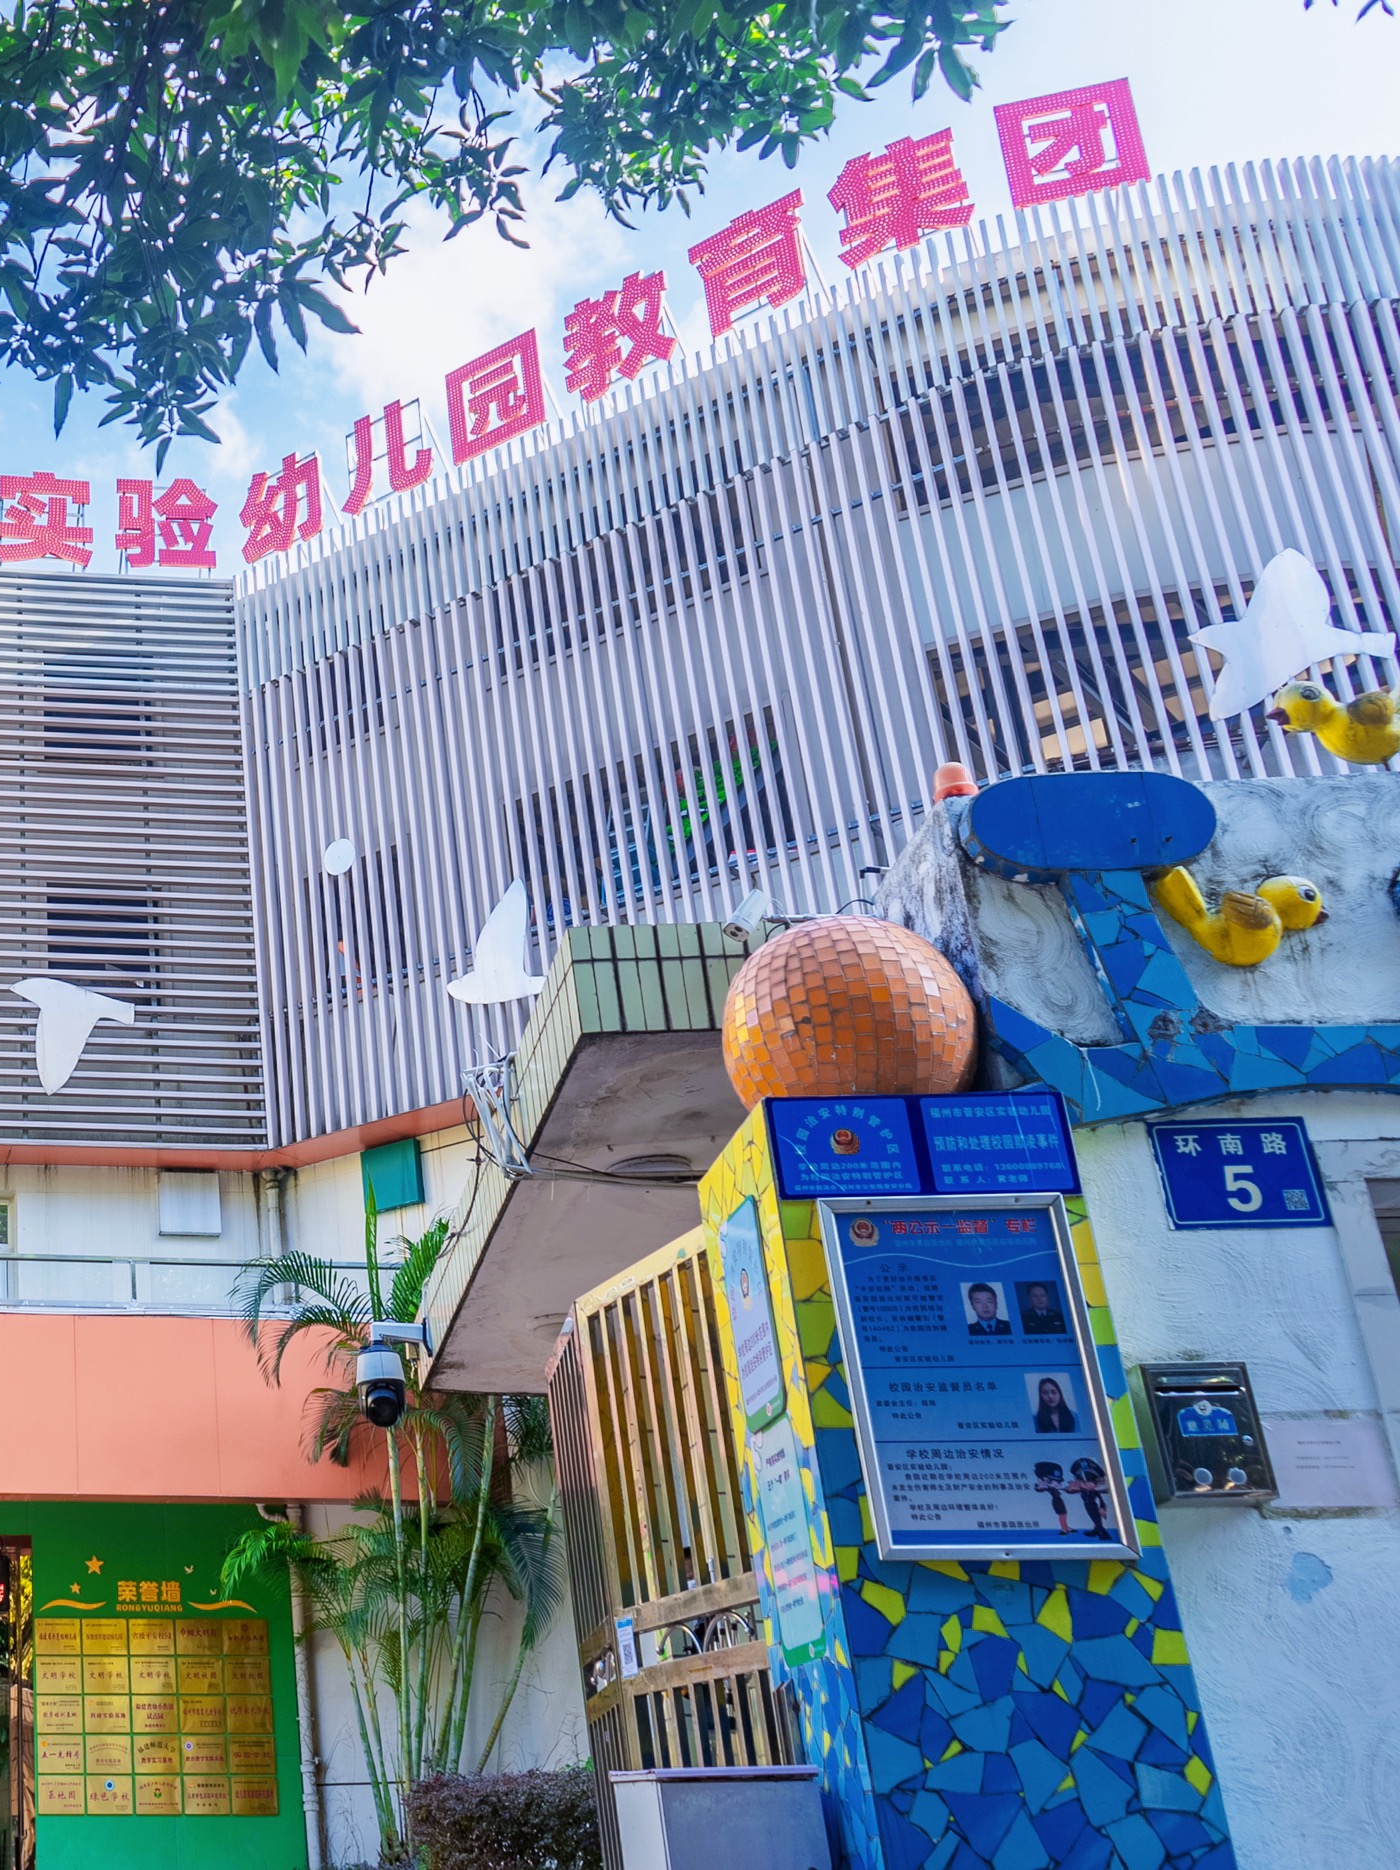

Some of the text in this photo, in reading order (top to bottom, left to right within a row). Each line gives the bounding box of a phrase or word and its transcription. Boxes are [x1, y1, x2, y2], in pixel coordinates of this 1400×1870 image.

[930, 1105, 1051, 1118] 福州市晋安区实验幼儿园
[795, 1104, 899, 1155] 校园治安特别管护区
[933, 1133, 1059, 1151] 预防和处理校园欺凌事件
[1173, 1132, 1287, 1157] 环南路
[798, 1161, 902, 1170] 学校周边200米范围内
[801, 1171, 902, 1181] 为校园治安特别管护区
[1223, 1165, 1263, 1212] 5
[1006, 1218, 1037, 1233] 专栏
[889, 1381, 998, 1393] 校园治安监督员名单
[892, 1412, 922, 1420] 特此公告
[957, 1421, 1019, 1429] 晋安区实验幼儿园
[906, 1448, 1004, 1460] 学校周边治安情况
[911, 1513, 942, 1521] 特此公告
[117, 1580, 181, 1602] 荣誉墙
[116, 1604, 183, 1612] RONGYUQIANG
[42, 1671, 77, 1680] 文明学校
[89, 1671, 123, 1680] 文明学校
[138, 1671, 171, 1680] 文明学校
[186, 1671, 217, 1680] 文明校园
[137, 1741, 176, 1754] 福建师范大学
[90, 1792, 129, 1801] 绿色学校
